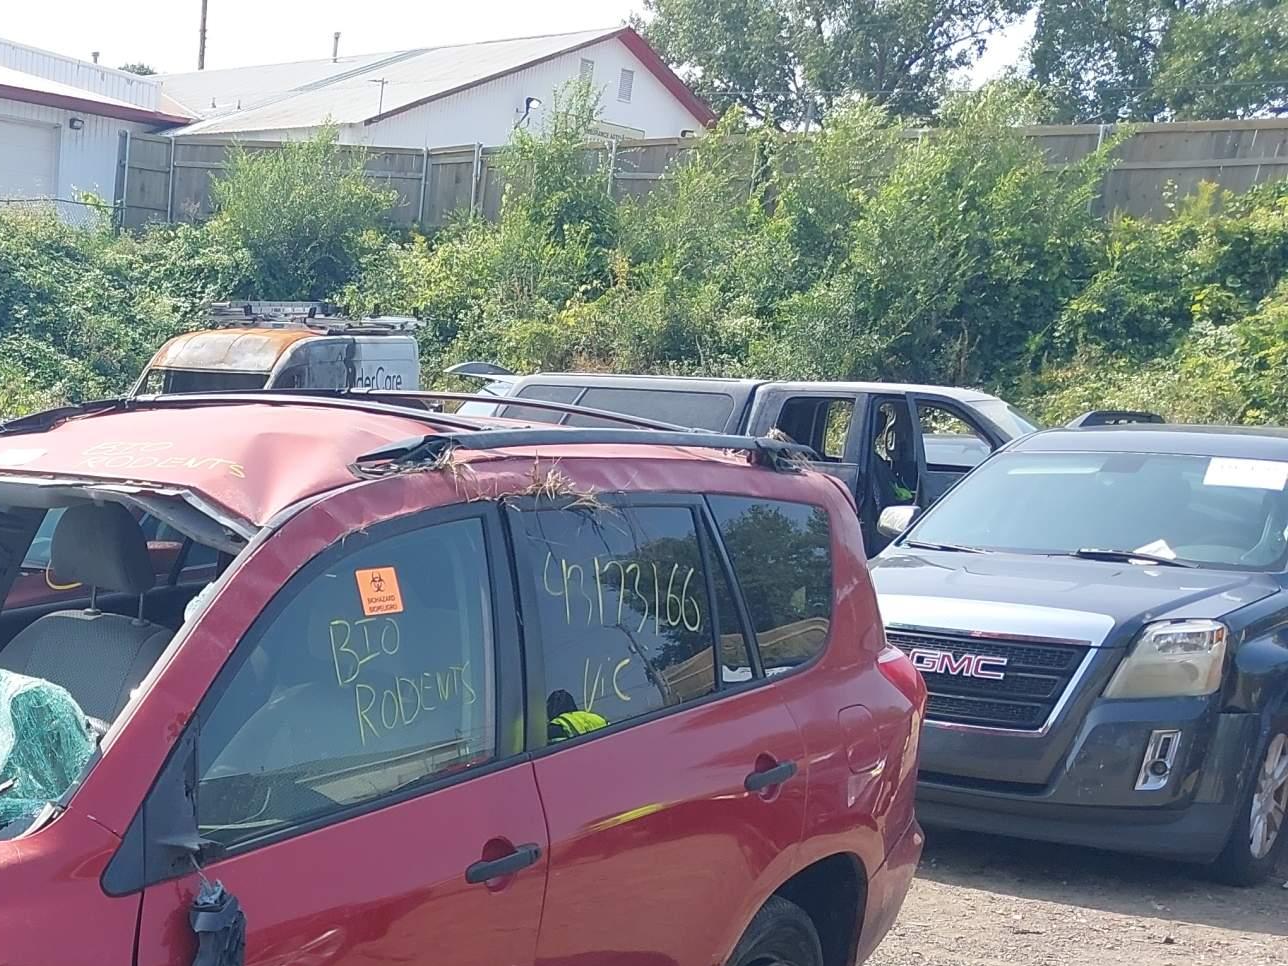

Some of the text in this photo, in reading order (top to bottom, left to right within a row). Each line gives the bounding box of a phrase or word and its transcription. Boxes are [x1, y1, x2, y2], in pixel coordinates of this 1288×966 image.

[74, 456, 245, 478] RODENTS
[543, 551, 701, 637] 43173166
[329, 617, 400, 687] BIO
[909, 648, 1008, 680] GMC
[355, 660, 477, 746] RODENTS
